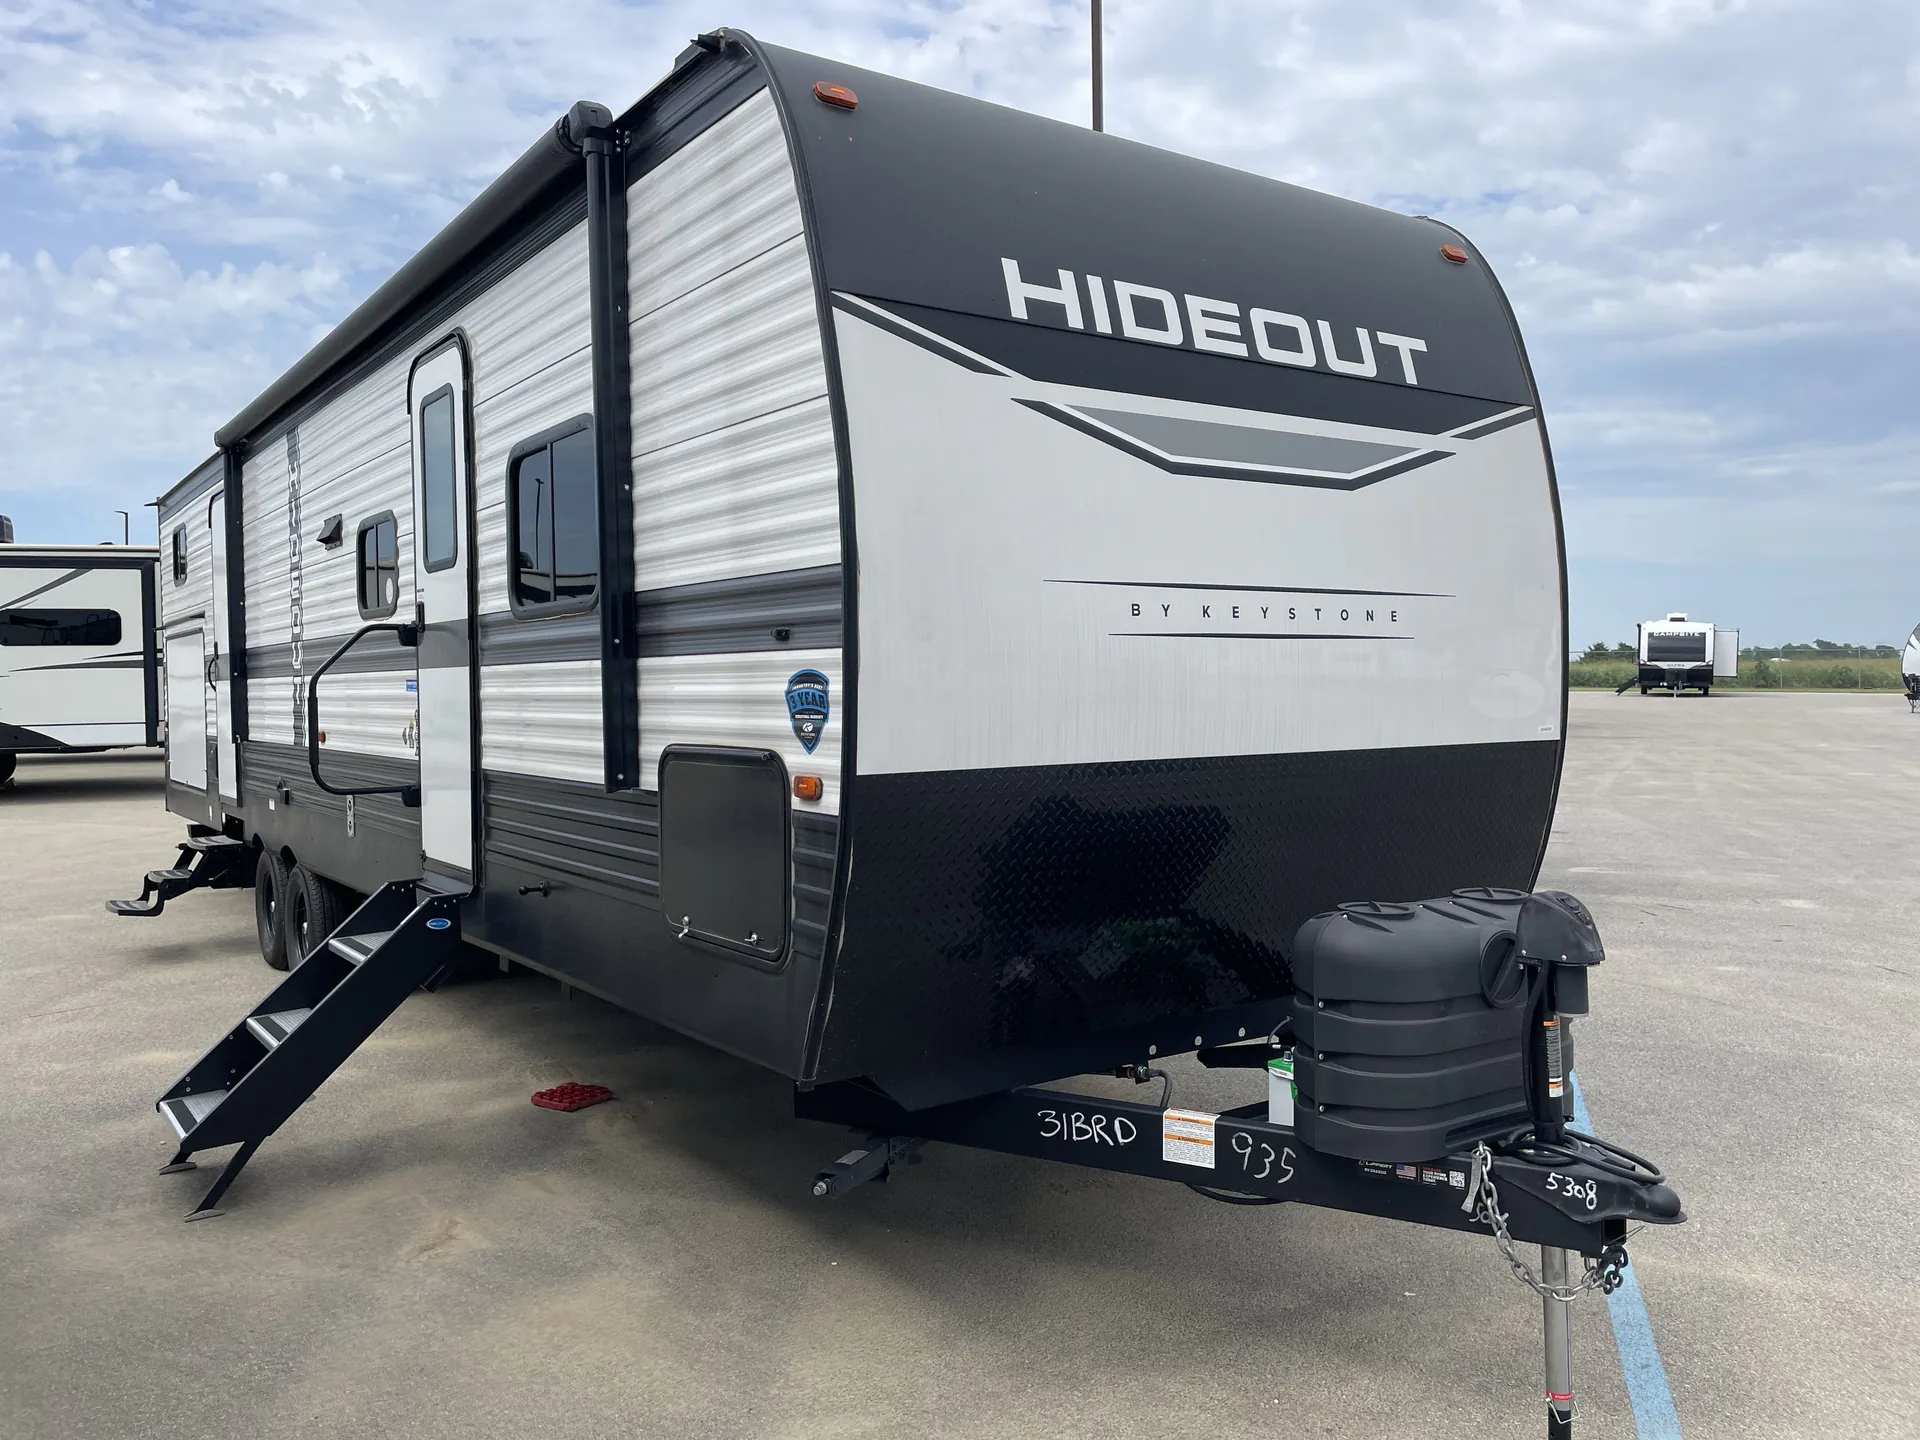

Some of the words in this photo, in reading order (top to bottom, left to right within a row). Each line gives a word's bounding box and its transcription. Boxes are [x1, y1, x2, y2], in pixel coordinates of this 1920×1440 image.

[1001, 256, 1428, 386] HIDEOUT
[1131, 602, 1172, 619] BY
[1201, 604, 1400, 623] KEYSTONE
[789, 695, 797, 710] 3
[798, 692, 826, 709] YEAR
[1037, 1109, 1137, 1147] 31BRD
[1231, 1131, 1297, 1184] 935
[1545, 1171, 1598, 1211] 5308
